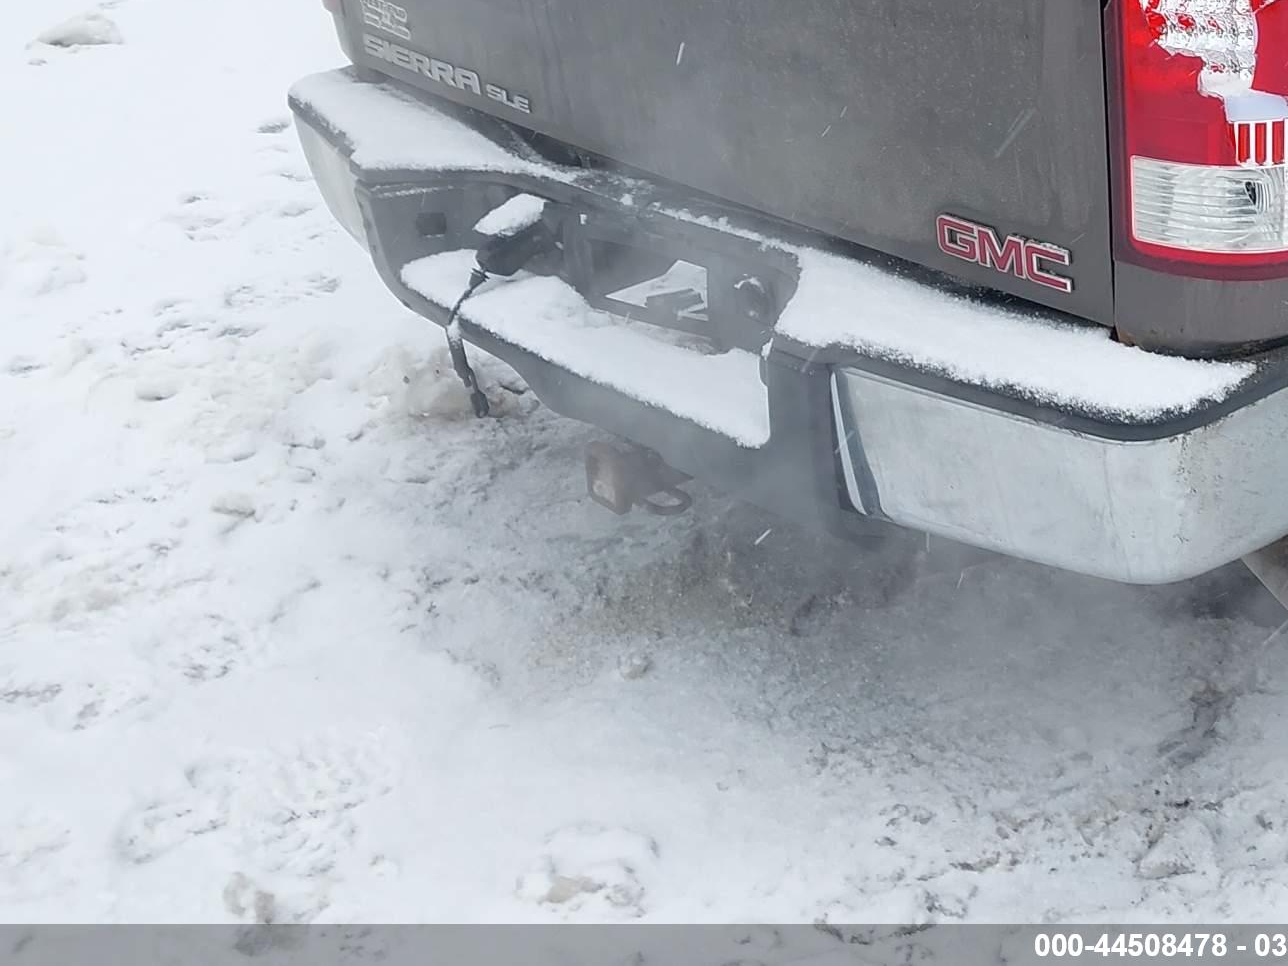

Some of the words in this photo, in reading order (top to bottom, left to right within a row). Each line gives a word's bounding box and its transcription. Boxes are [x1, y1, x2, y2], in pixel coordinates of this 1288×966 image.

[363, 34, 482, 96] SIERRA
[486, 83, 531, 114] SLE
[936, 213, 1073, 294] GMC
